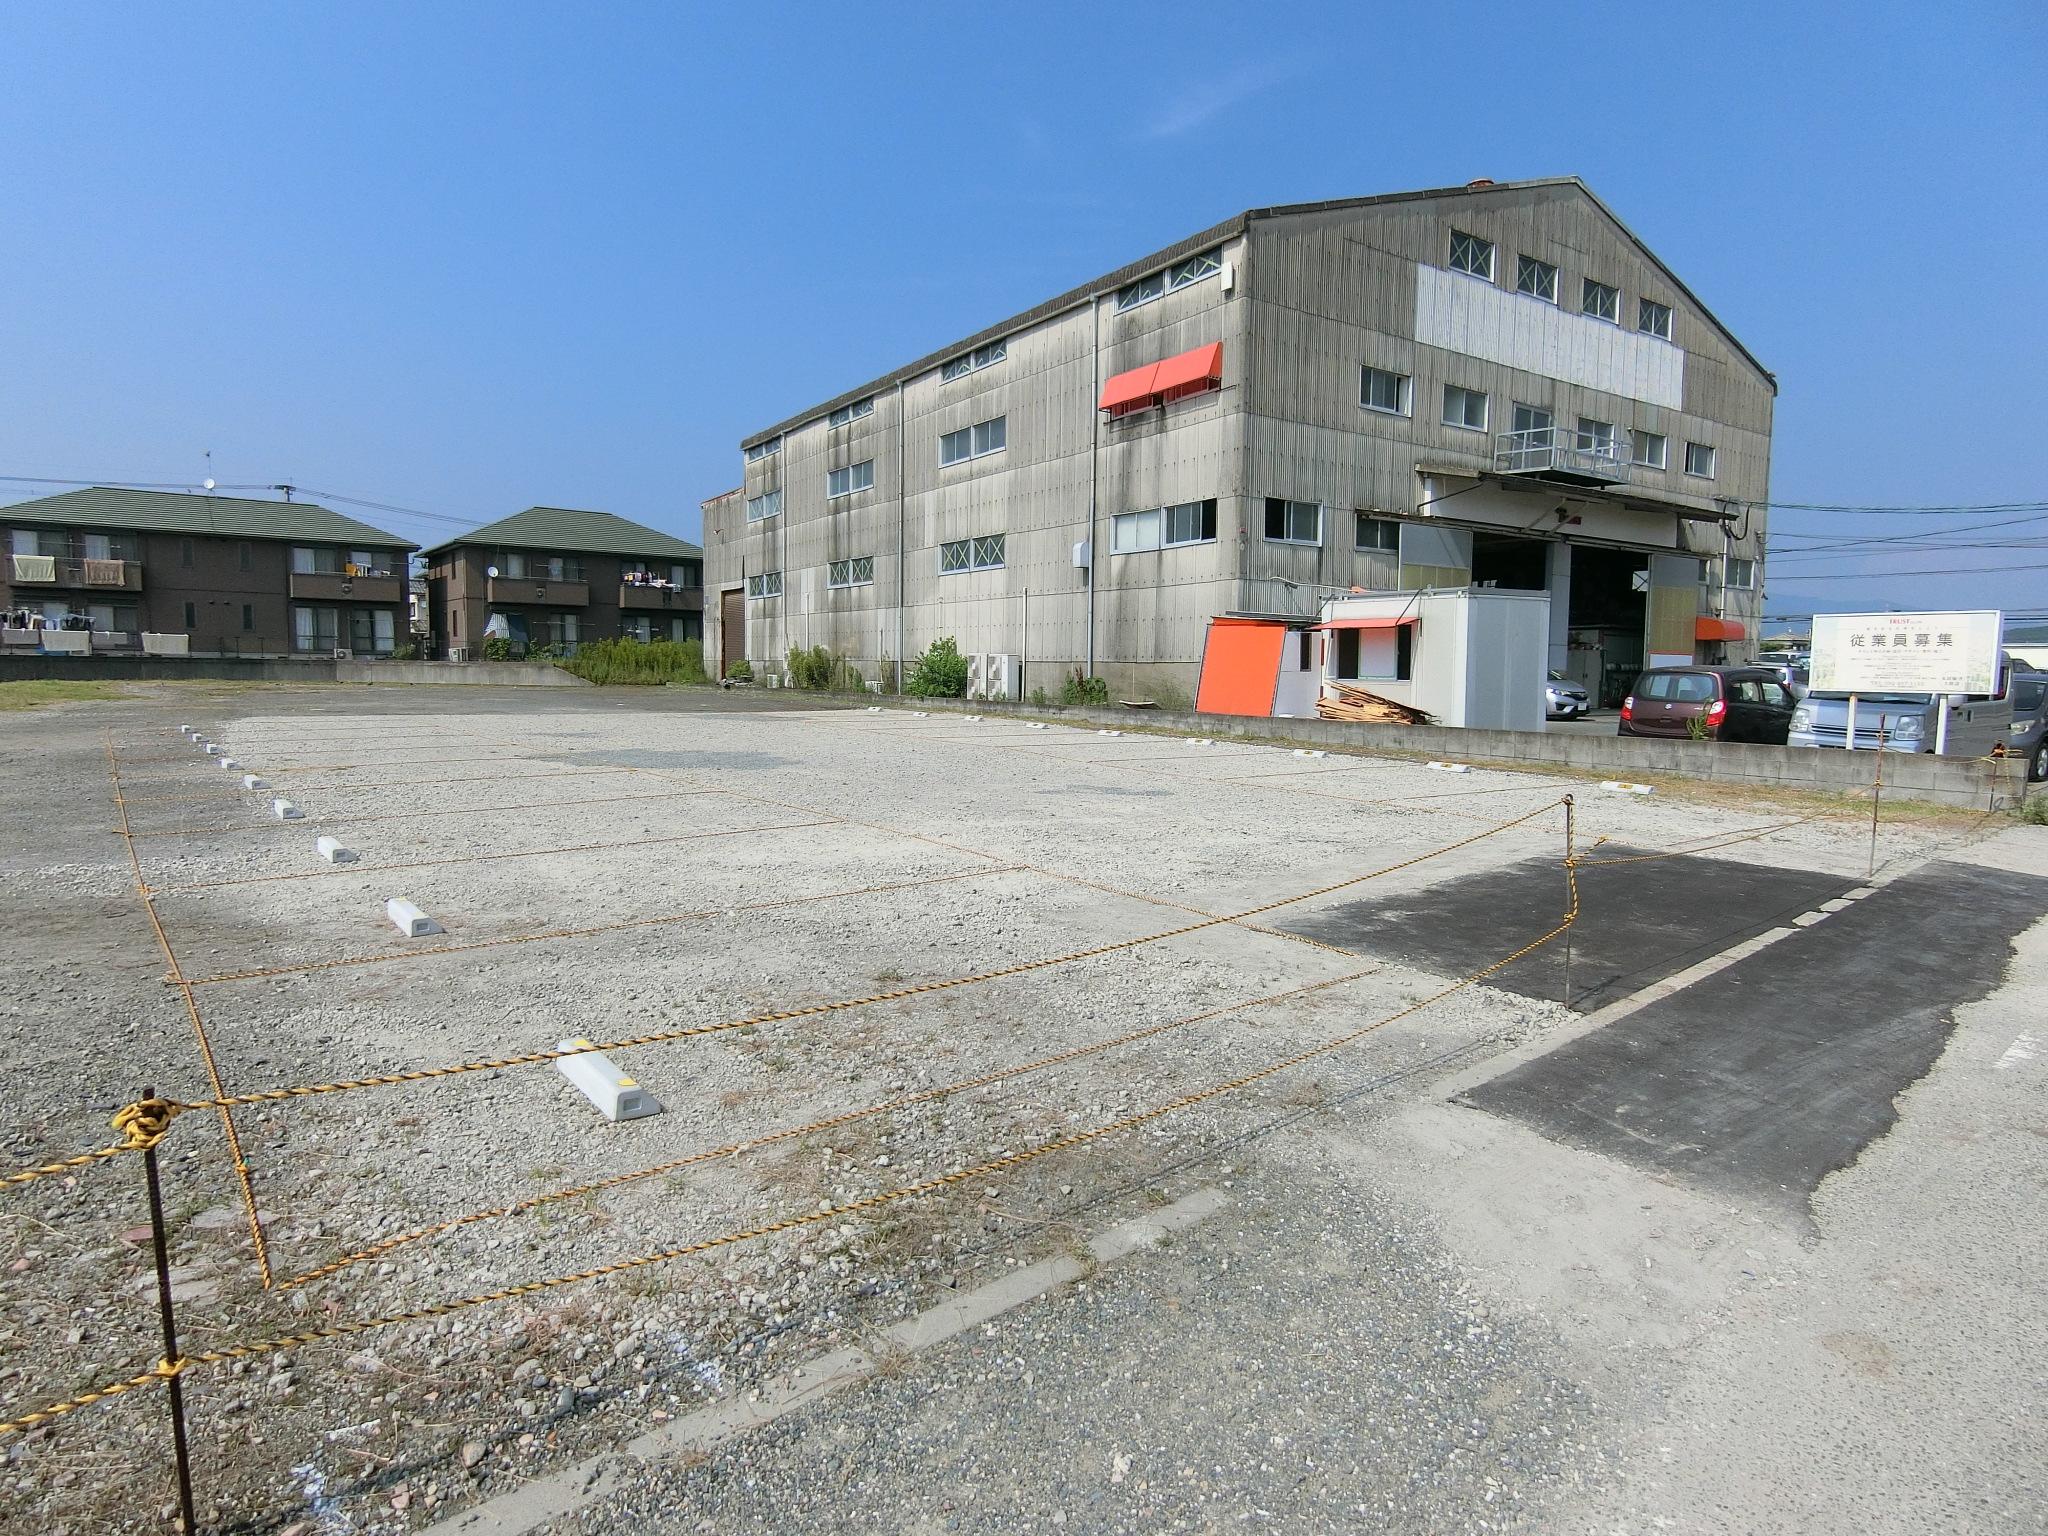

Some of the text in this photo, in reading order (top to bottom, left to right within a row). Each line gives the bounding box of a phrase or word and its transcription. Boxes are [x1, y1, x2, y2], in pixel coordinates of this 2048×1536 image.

[1850, 633, 1953, 648] 従業員募集
